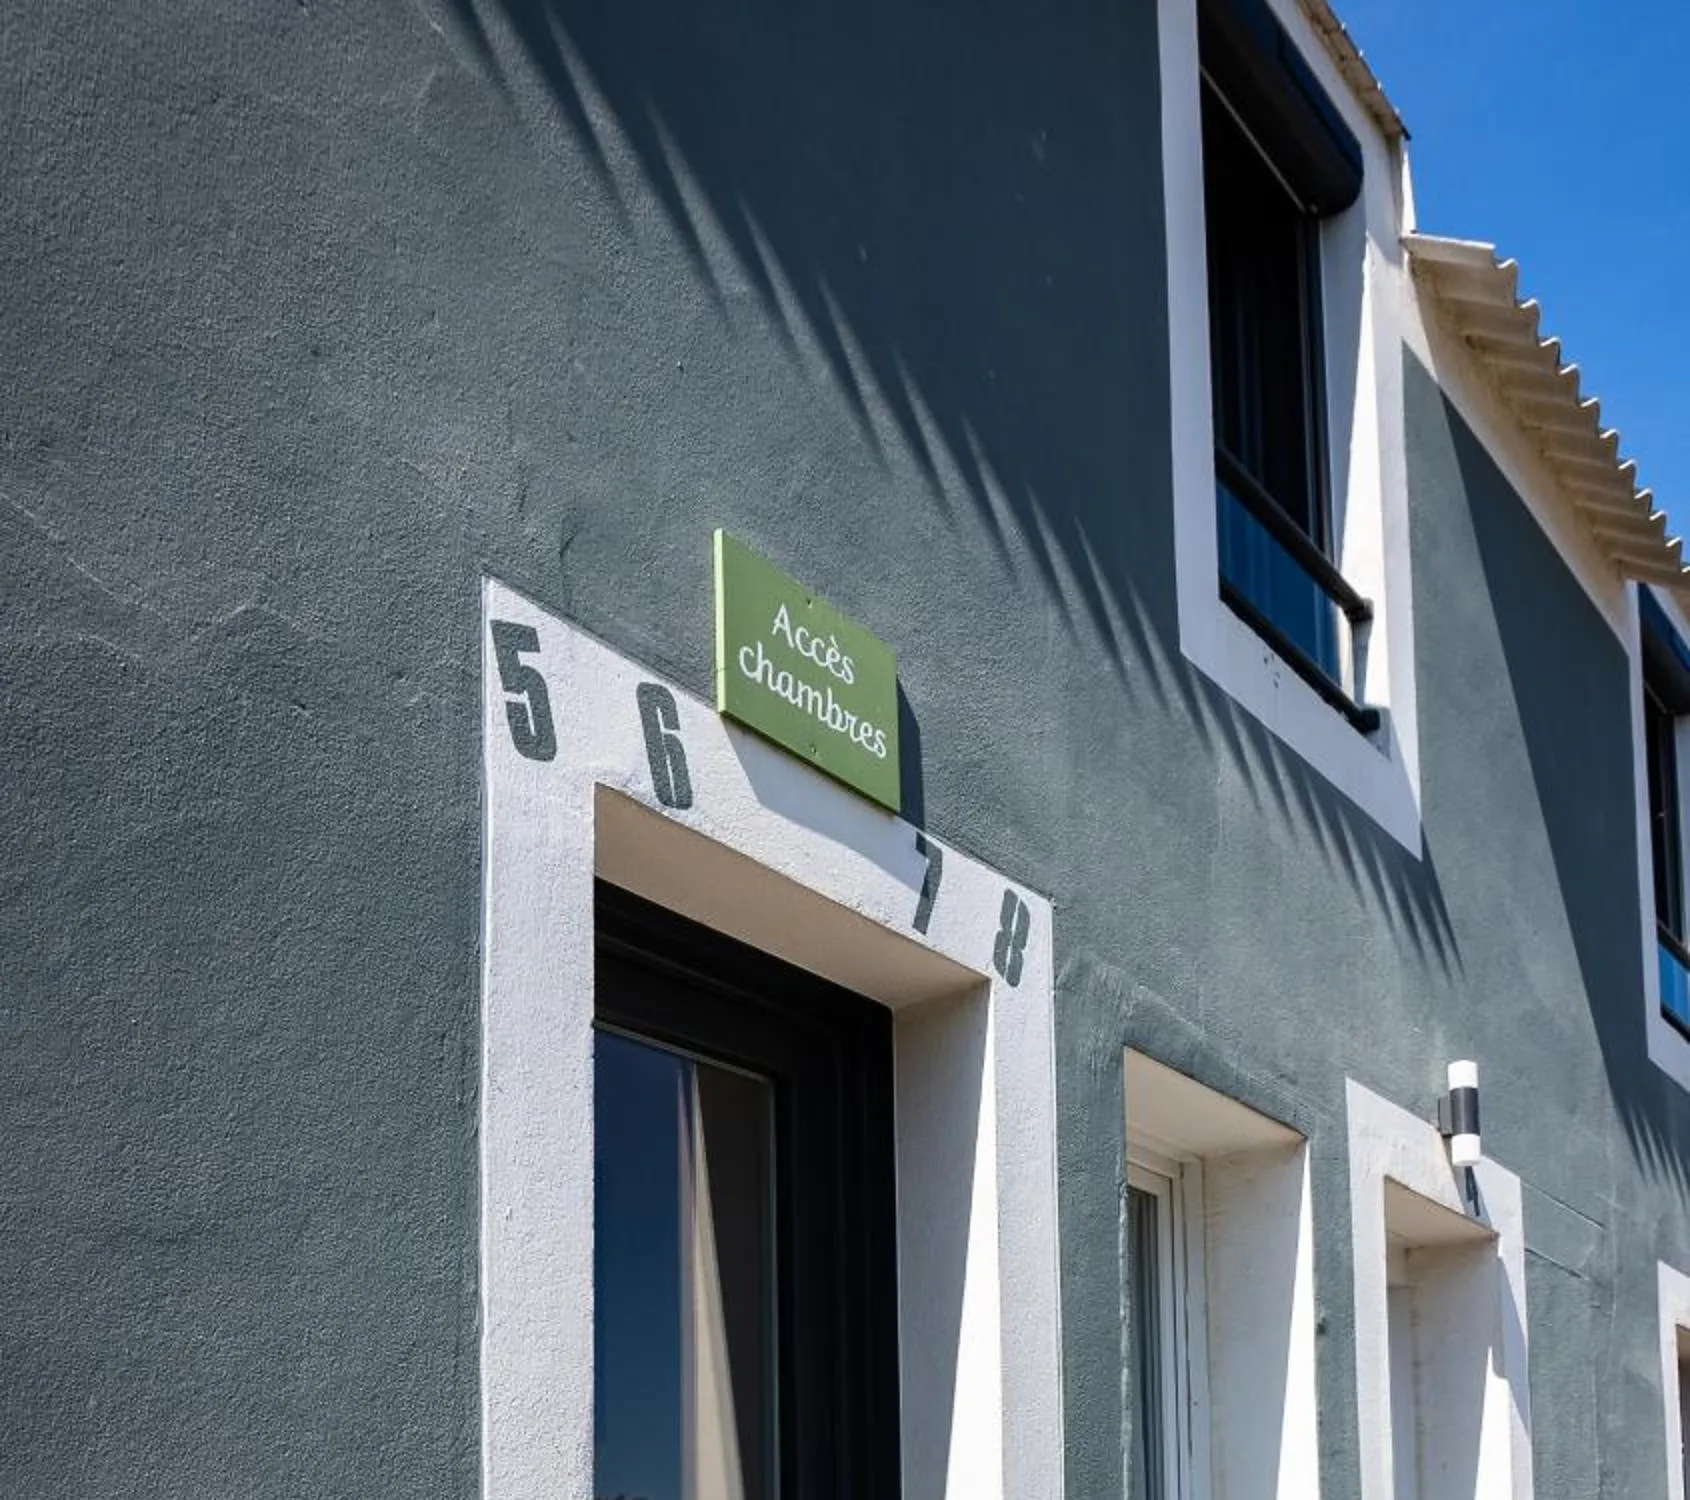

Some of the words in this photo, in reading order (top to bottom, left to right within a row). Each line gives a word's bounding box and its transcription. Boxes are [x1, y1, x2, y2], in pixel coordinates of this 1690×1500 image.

[738, 640, 888, 759] chambres
[772, 603, 854, 685] Accès
[489, 619, 558, 763] 5
[636, 681, 694, 810] 6
[912, 831, 943, 936] 7
[993, 887, 1031, 988] 8
